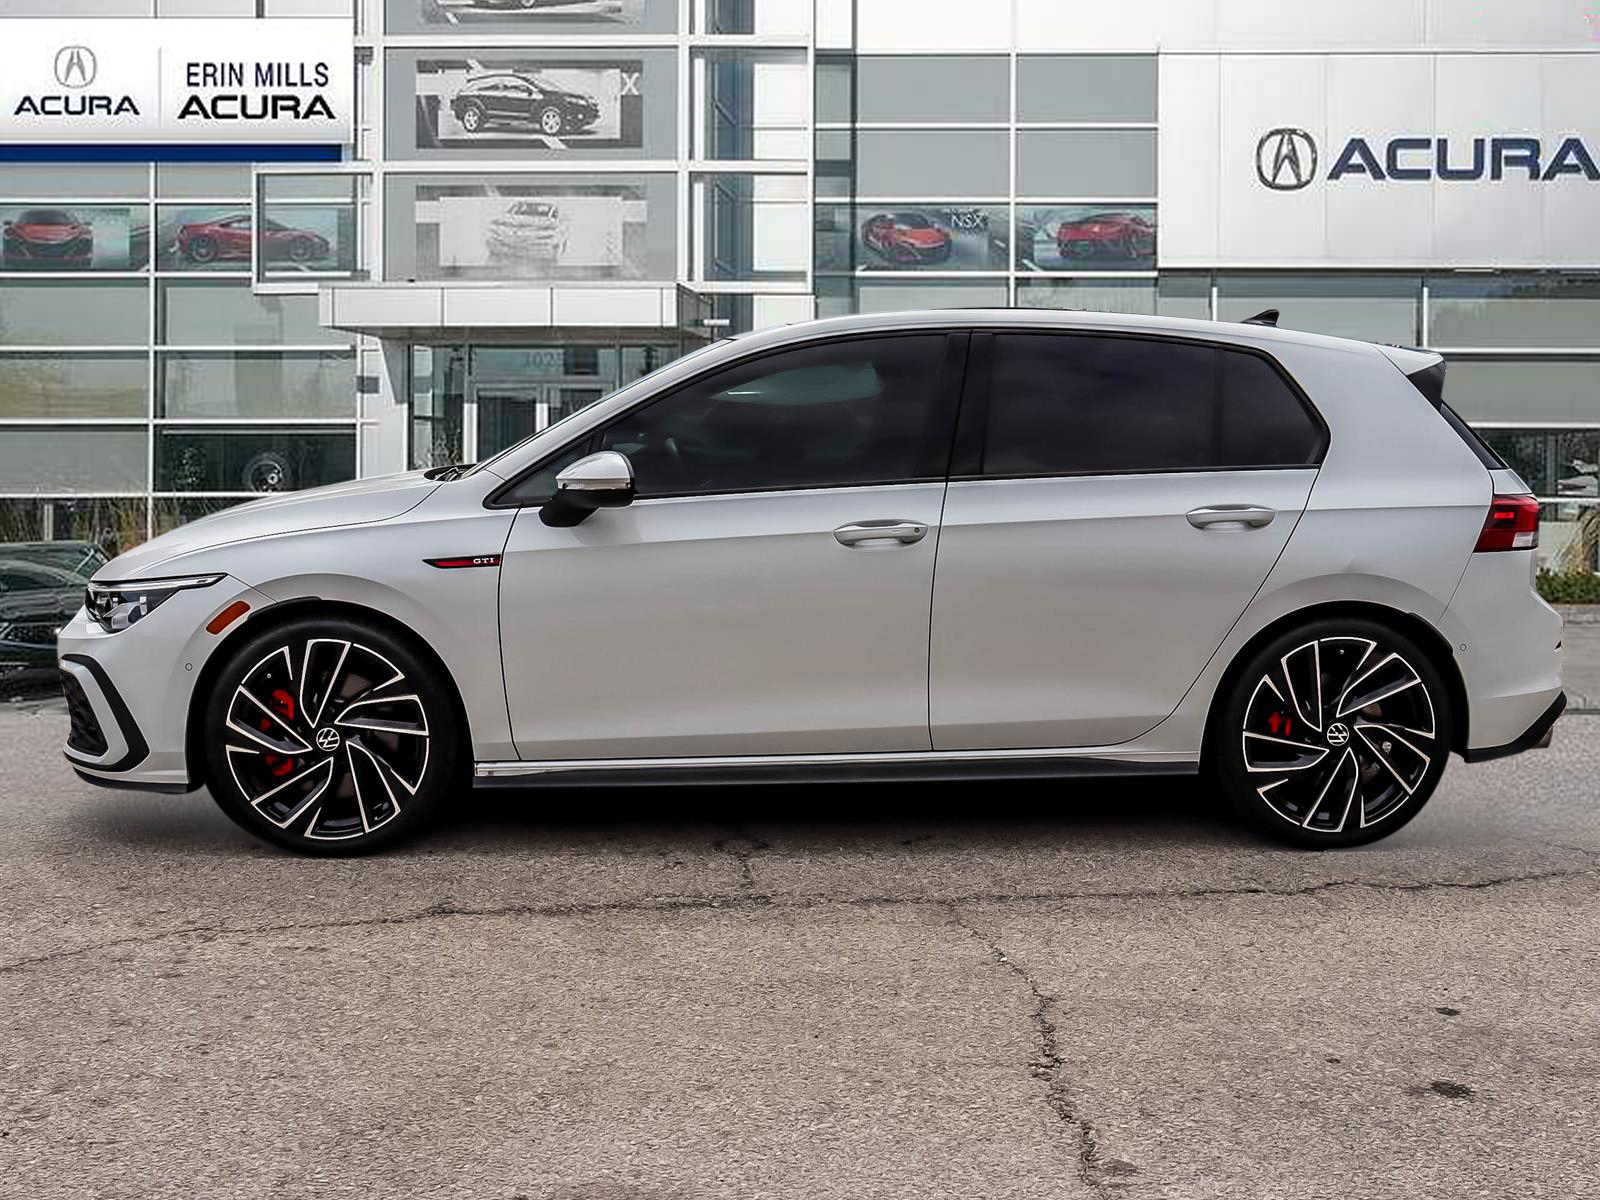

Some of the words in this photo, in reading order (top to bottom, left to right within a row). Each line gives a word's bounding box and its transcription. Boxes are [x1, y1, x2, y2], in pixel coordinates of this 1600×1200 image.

[186, 62, 243, 87] ERIN
[255, 62, 329, 87] MILLS
[14, 96, 140, 116] ACURA
[178, 95, 336, 119] ACURA
[1327, 137, 1600, 181] ACURA
[473, 557, 495, 565] GTI
